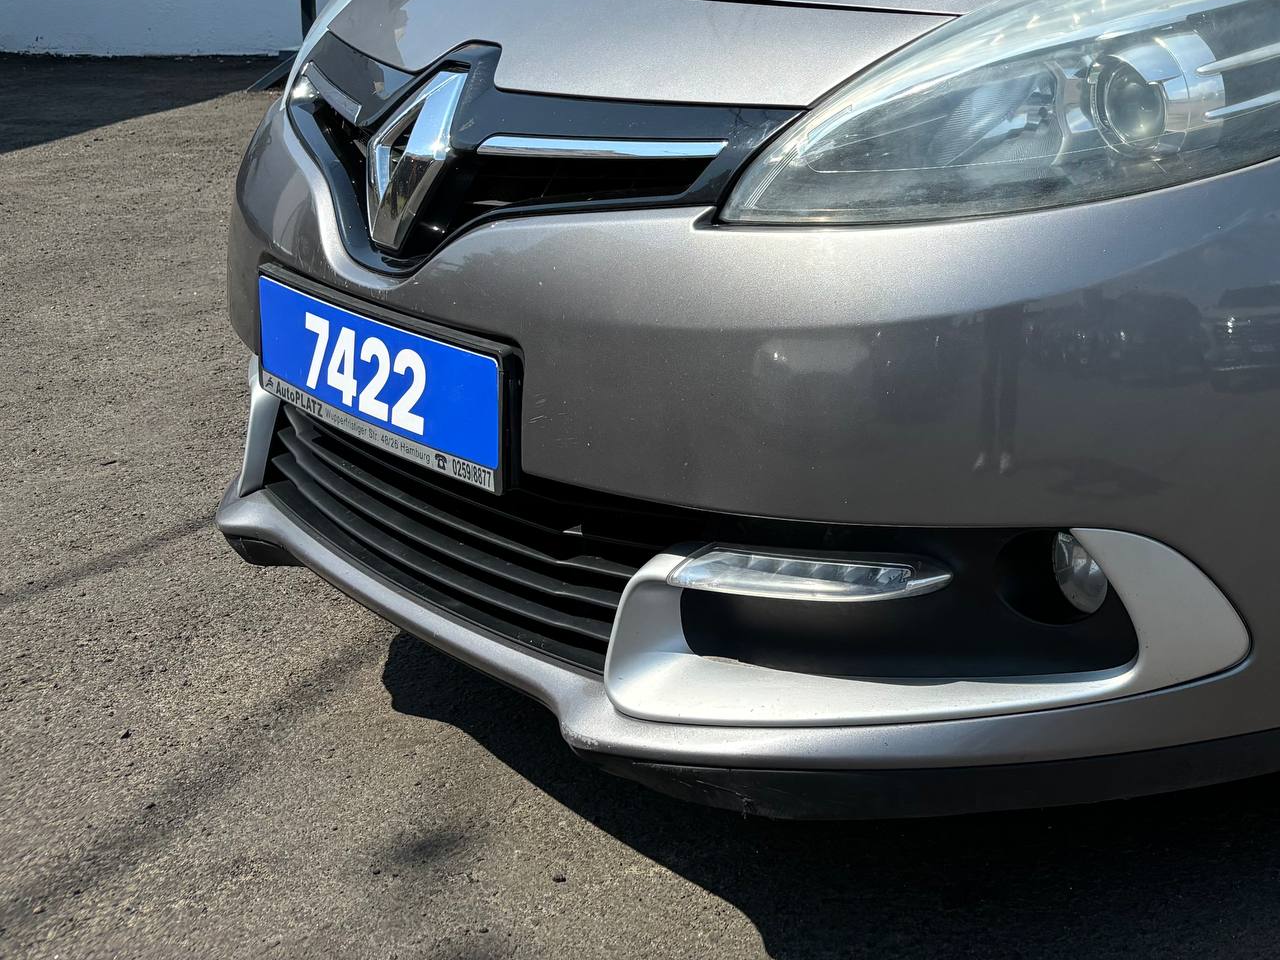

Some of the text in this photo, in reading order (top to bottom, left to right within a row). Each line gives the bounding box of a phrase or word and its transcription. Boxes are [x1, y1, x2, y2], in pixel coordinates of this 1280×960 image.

[276, 381, 323, 418] AutoPLATZ
[400, 441, 431, 464] Hamburg
[305, 311, 427, 436] 7422
